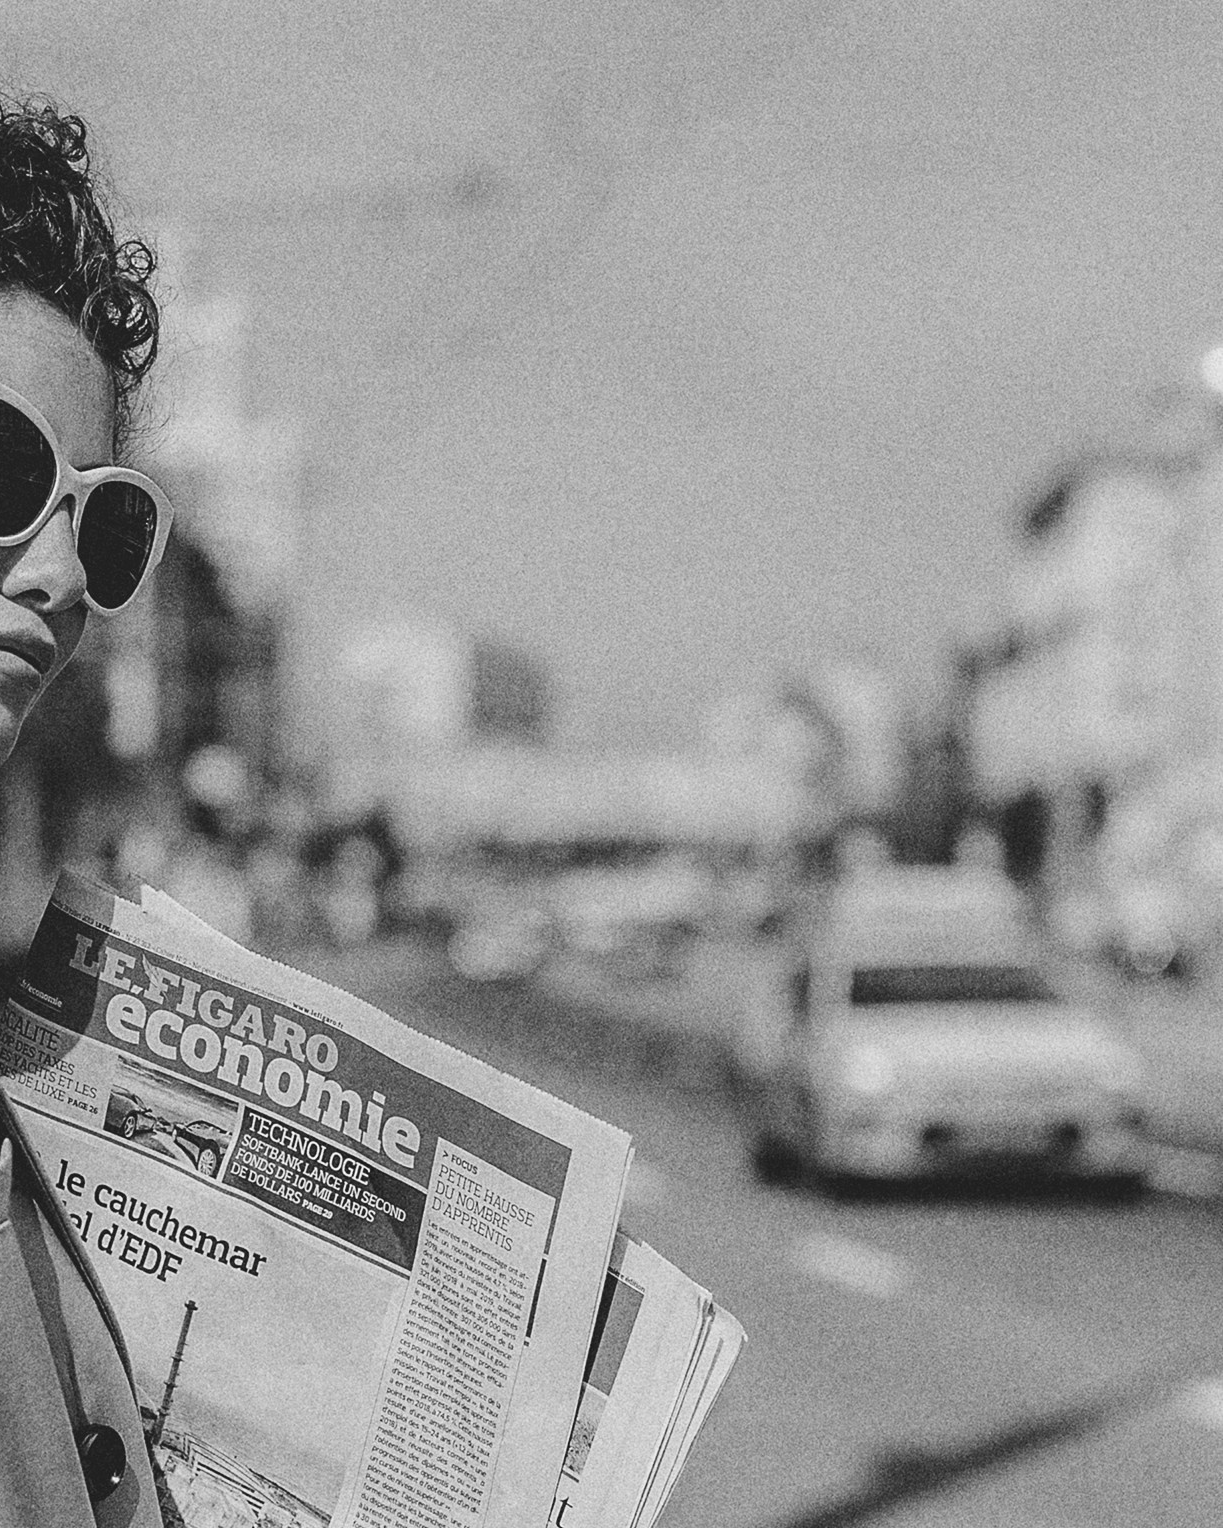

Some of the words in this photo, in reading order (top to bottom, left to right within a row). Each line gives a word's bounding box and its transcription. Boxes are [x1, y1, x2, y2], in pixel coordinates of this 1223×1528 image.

[68, 934, 137, 991] LE
[141, 952, 340, 1070] FIGARO
[11, 1052, 57, 1083] YACHTS
[57, 1075, 74, 1090] ET
[73, 1081, 97, 1100] LES
[14, 1039, 37, 1059] DES
[35, 1050, 75, 1076] TAXES
[105, 984, 420, 1167] économie
[17, 1073, 35, 1089] DE
[34, 1080, 66, 1102] LUXE
[67, 1096, 89, 1111] PAGE
[88, 1105, 98, 1115] 26
[248, 1111, 372, 1186] TECHNOLOGIE
[450, 1153, 479, 1175] FOCUS
[230, 1161, 248, 1179] DE
[246, 1168, 302, 1204] DOLLARS
[301, 1198, 323, 1215] PAGE
[234, 1147, 275, 1175] FONDS
[275, 1166, 293, 1183] DE
[291, 1174, 314, 1193] 100
[311, 1183, 376, 1223] MILLIARDS
[241, 1133, 303, 1172] SOFTBANK
[302, 1162, 344, 1191] LANCE
[341, 1181, 362, 1199] UN
[359, 1190, 406, 1221] SECOND
[437, 1164, 484, 1199] PETITE
[482, 1189, 535, 1227] HAUSSE
[55, 1159, 86, 1197] le
[94, 1184, 267, 1277] cauchemar
[431, 1196, 513, 1252] D'APPRENTIS
[435, 1180, 455, 1200] DU
[455, 1192, 510, 1232] NOMBRE
[97, 1223, 183, 1283] d'EDF
[371, 1445, 409, 1468] progression
[408, 1463, 420, 1474] des
[378, 1459, 400, 1474] cursus
